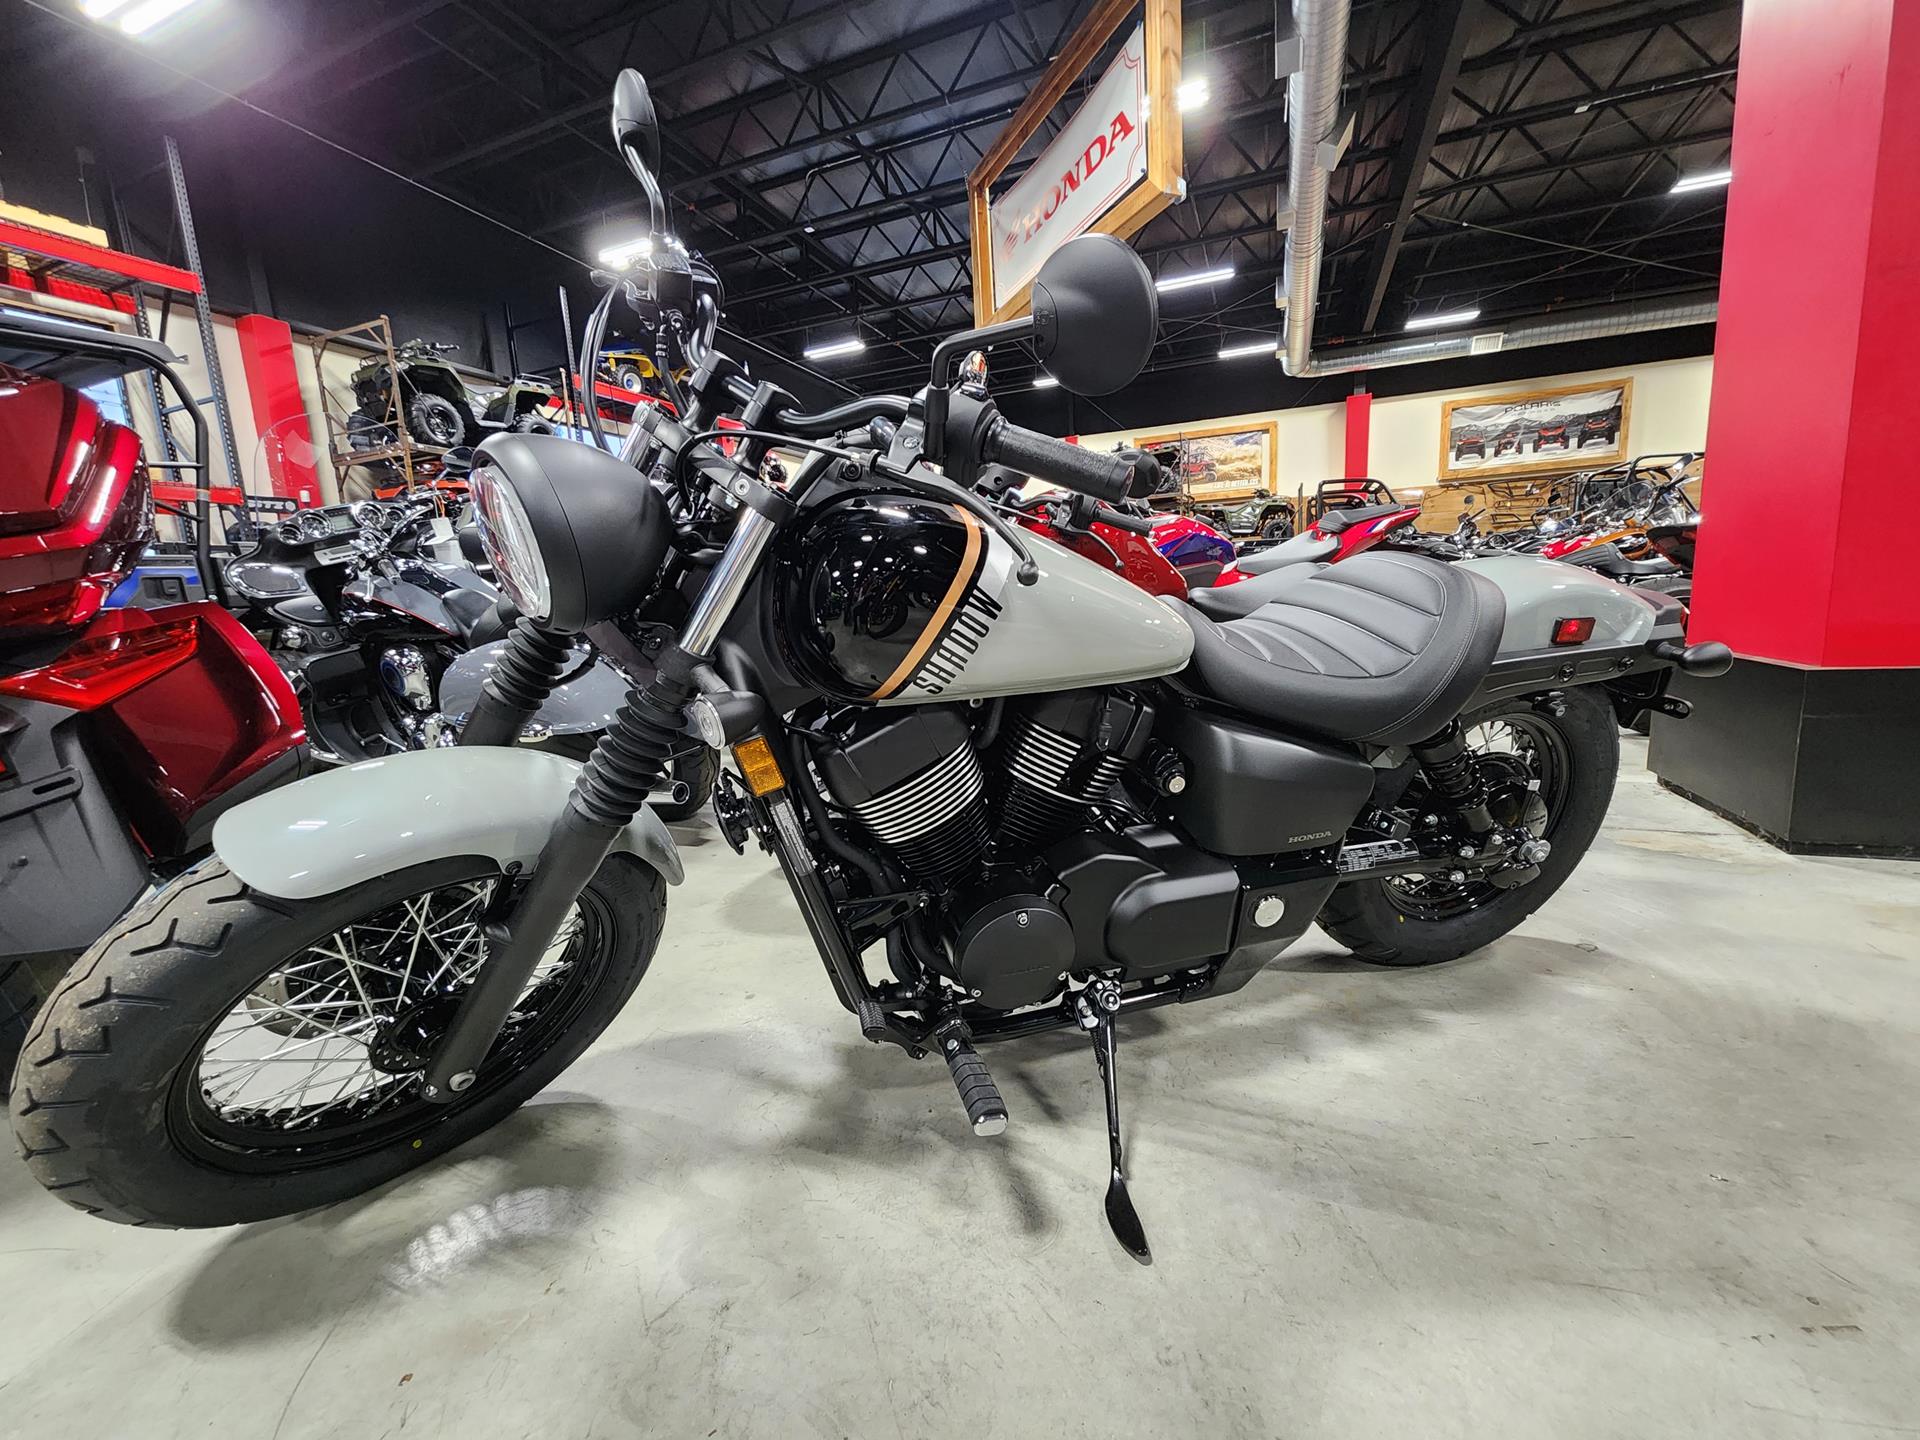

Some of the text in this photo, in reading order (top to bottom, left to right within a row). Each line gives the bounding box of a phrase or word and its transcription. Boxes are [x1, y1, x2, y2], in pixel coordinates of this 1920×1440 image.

[1023, 111, 1135, 244] HONDA
[1504, 400, 1561, 414] POLARIS
[912, 585, 1004, 695] SHADOW
[1288, 831, 1332, 844] HONDA
